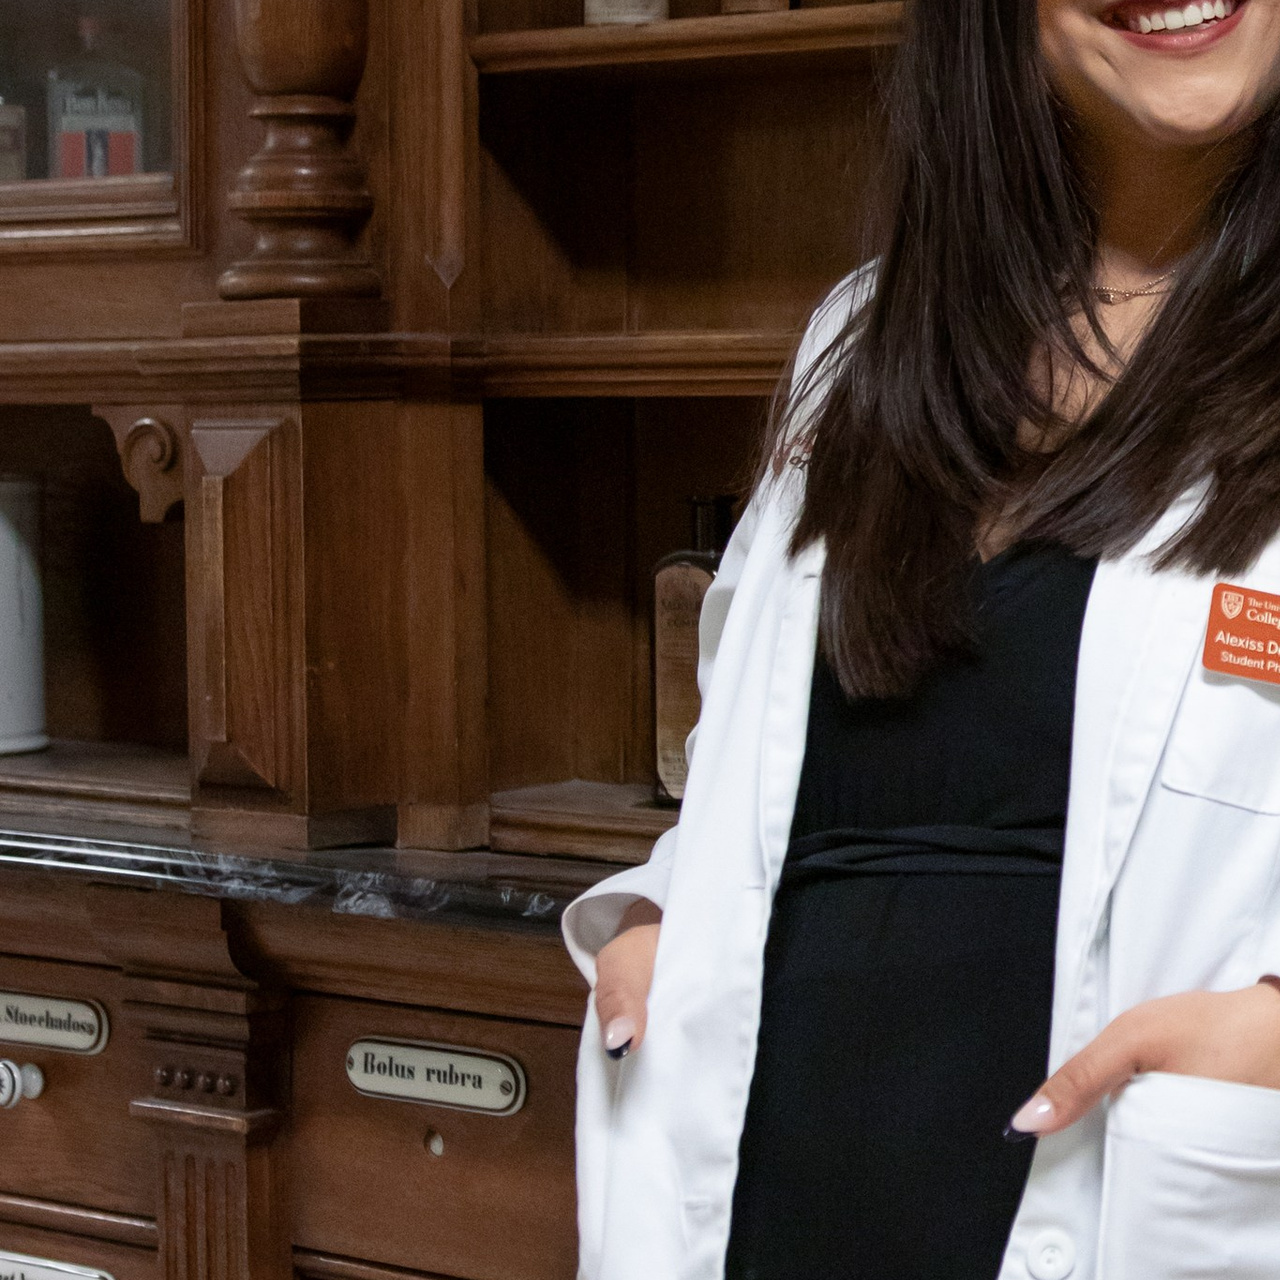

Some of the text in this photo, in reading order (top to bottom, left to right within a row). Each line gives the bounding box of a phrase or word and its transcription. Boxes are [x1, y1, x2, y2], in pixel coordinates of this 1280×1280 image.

[1248, 596, 1263, 608] The
[1215, 630, 1264, 653] Alexiss
[1221, 652, 1265, 670] Student
[363, 1051, 483, 1090] Bolus rubra
